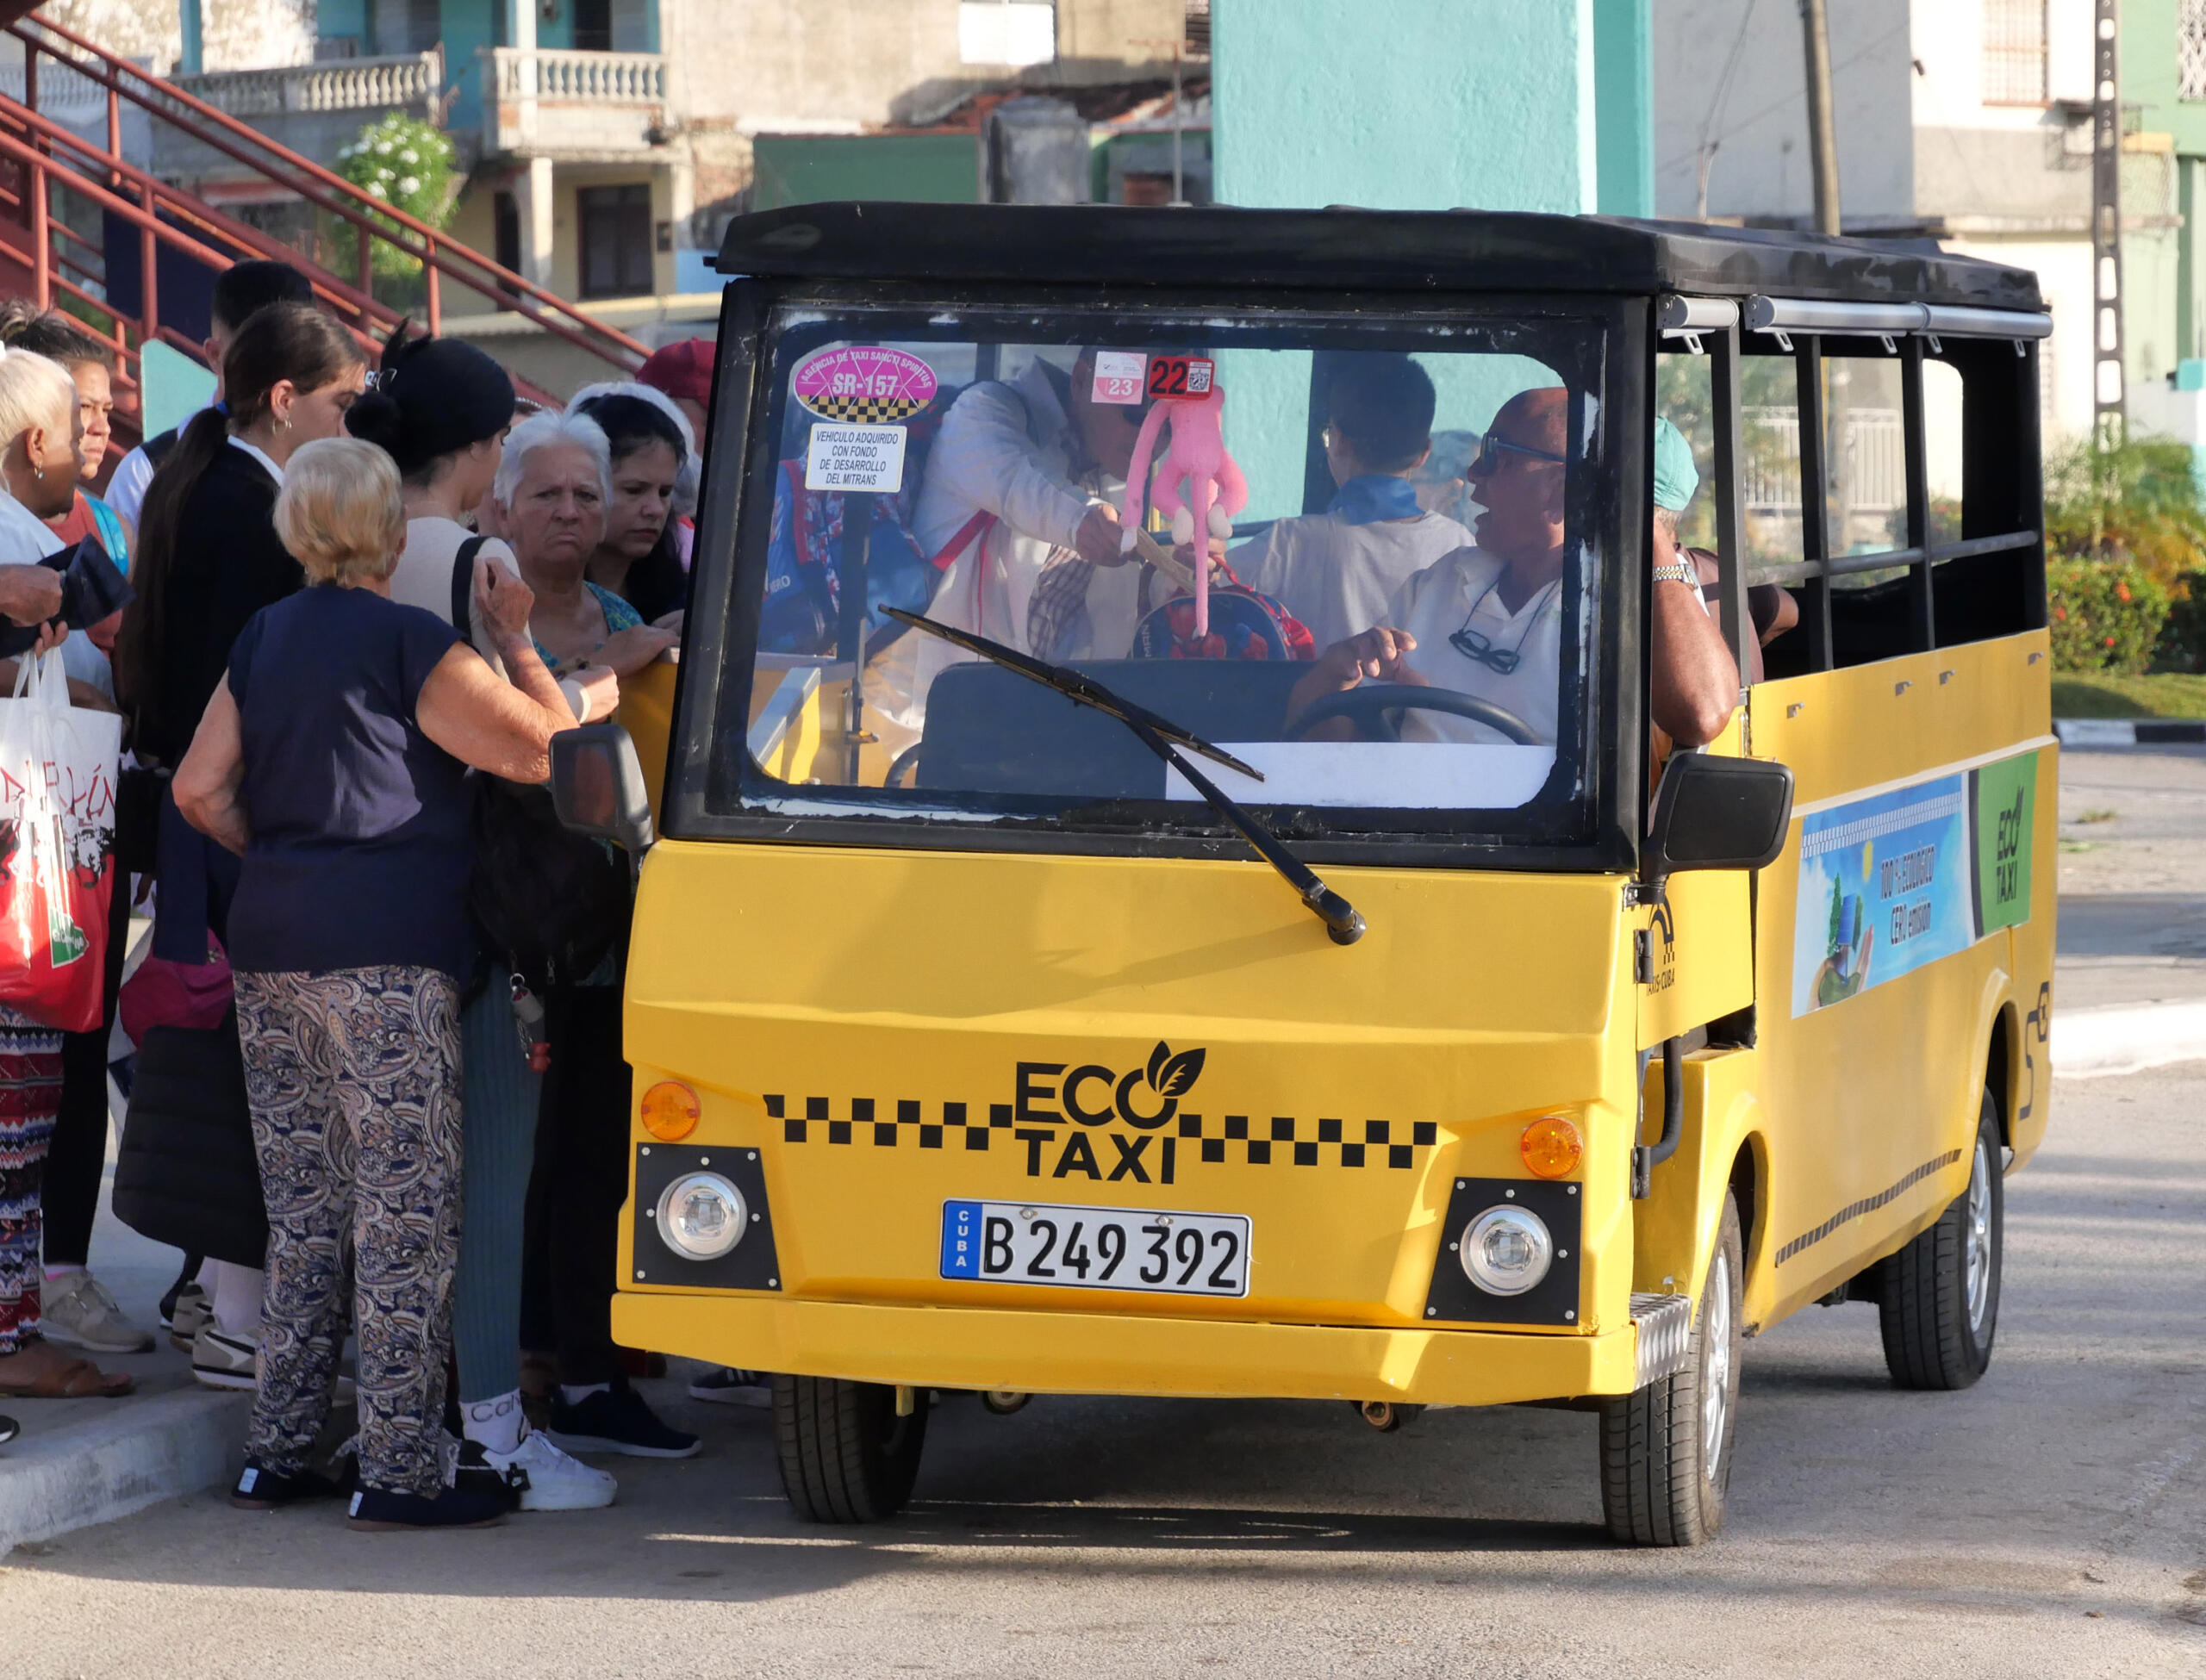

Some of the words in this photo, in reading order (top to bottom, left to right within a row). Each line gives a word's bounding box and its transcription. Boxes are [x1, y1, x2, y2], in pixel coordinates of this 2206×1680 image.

[801, 357, 835, 383] AGENCIA
[837, 352, 849, 363] DE
[851, 351, 869, 360] TAXI
[870, 352, 900, 364] SANCTI
[900, 358, 932, 388] SPIRITUS
[832, 373, 899, 396] SR-157
[1108, 378, 1133, 396] 23
[1150, 360, 1188, 395] 22
[832, 445, 849, 457] CON
[850, 446, 878, 458] FONDO
[855, 432, 899, 445] ADQUIRIDO
[819, 459, 832, 470] DE
[834, 459, 887, 472] DESARROLLO
[826, 473, 841, 484] DEL
[842, 473, 877, 486] MITRANS
[1997, 801, 2019, 862] ECO
[1997, 860, 2018, 905] TAXI
[1015, 1059, 1179, 1129] ECO
[1014, 1129, 1176, 1185] TAXI
[956, 1210, 969, 1268] CUBA
[983, 1216, 1014, 1274] B
